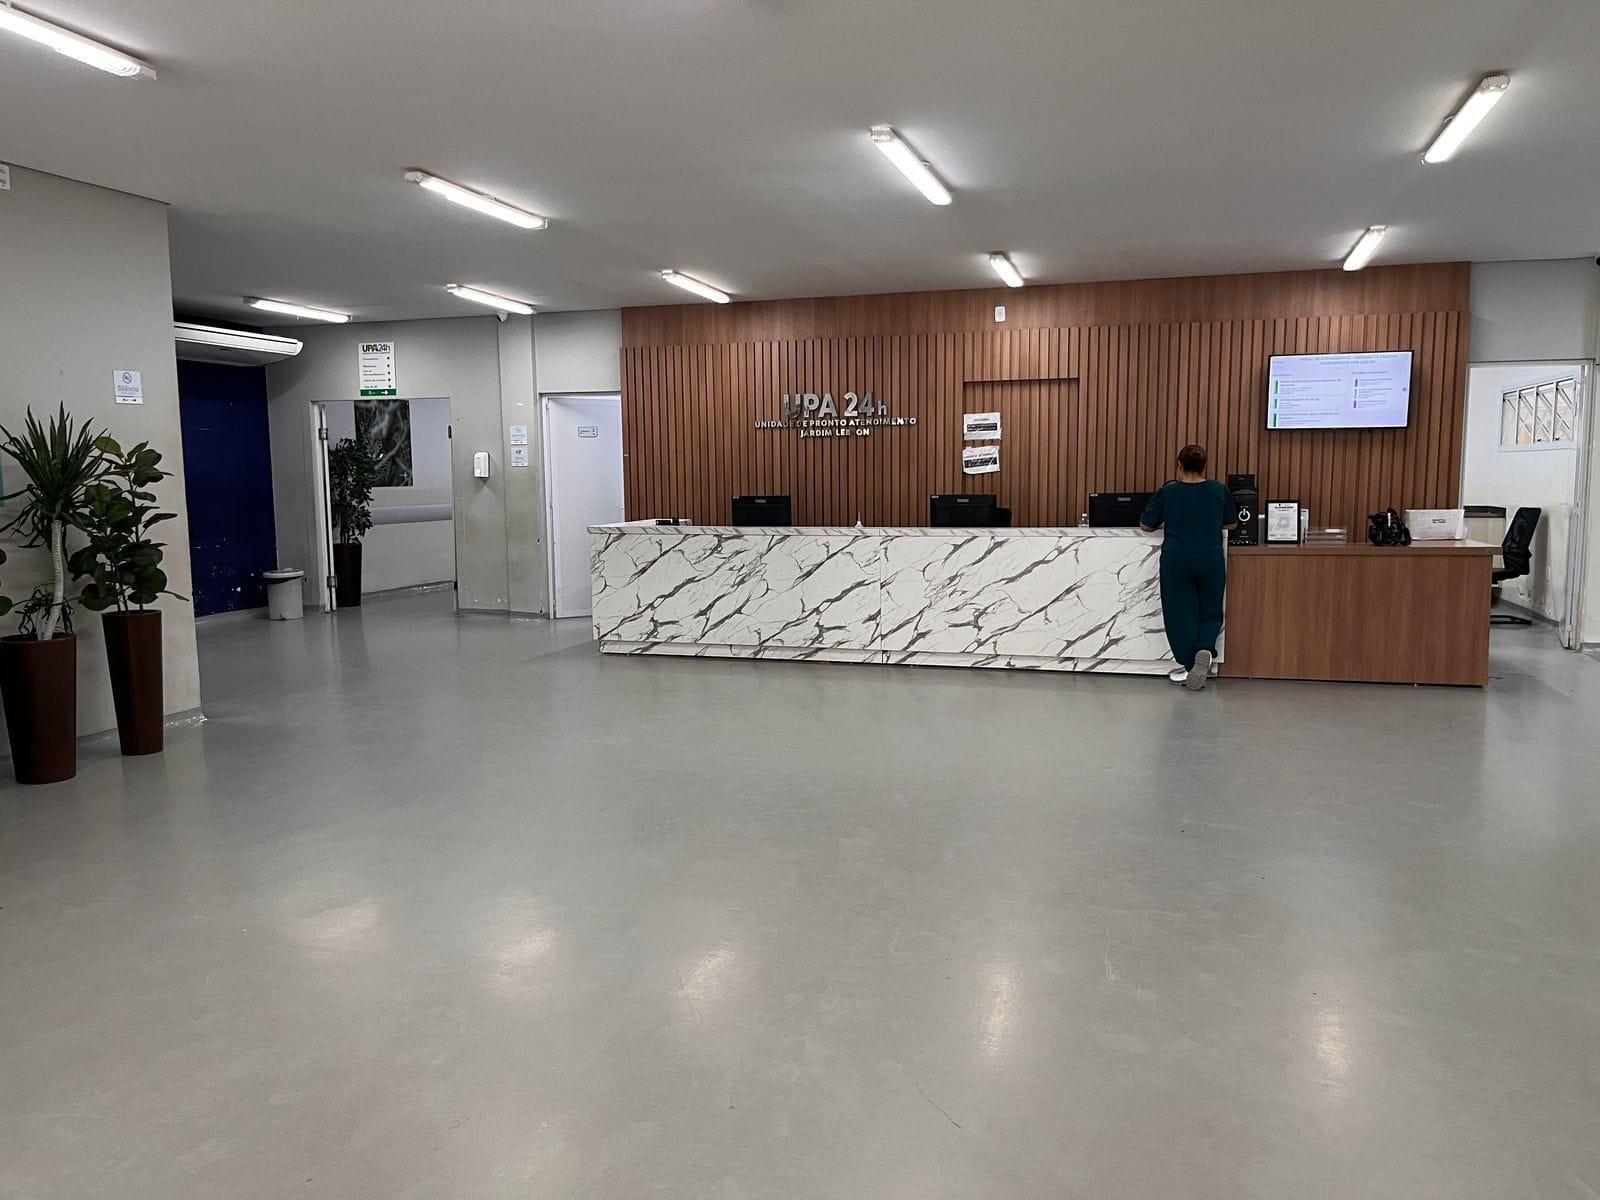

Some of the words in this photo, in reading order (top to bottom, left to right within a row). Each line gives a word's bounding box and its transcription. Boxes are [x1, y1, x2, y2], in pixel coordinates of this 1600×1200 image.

[783, 393, 837, 419] UPA
[755, 420, 795, 428] UNIDADE
[796, 419, 808, 427] DE
[809, 419, 847, 427] PRONTO
[849, 417, 917, 427] ATENDIMENTO
[800, 429, 832, 438] JARDIM
[836, 428, 870, 437] LEBON
